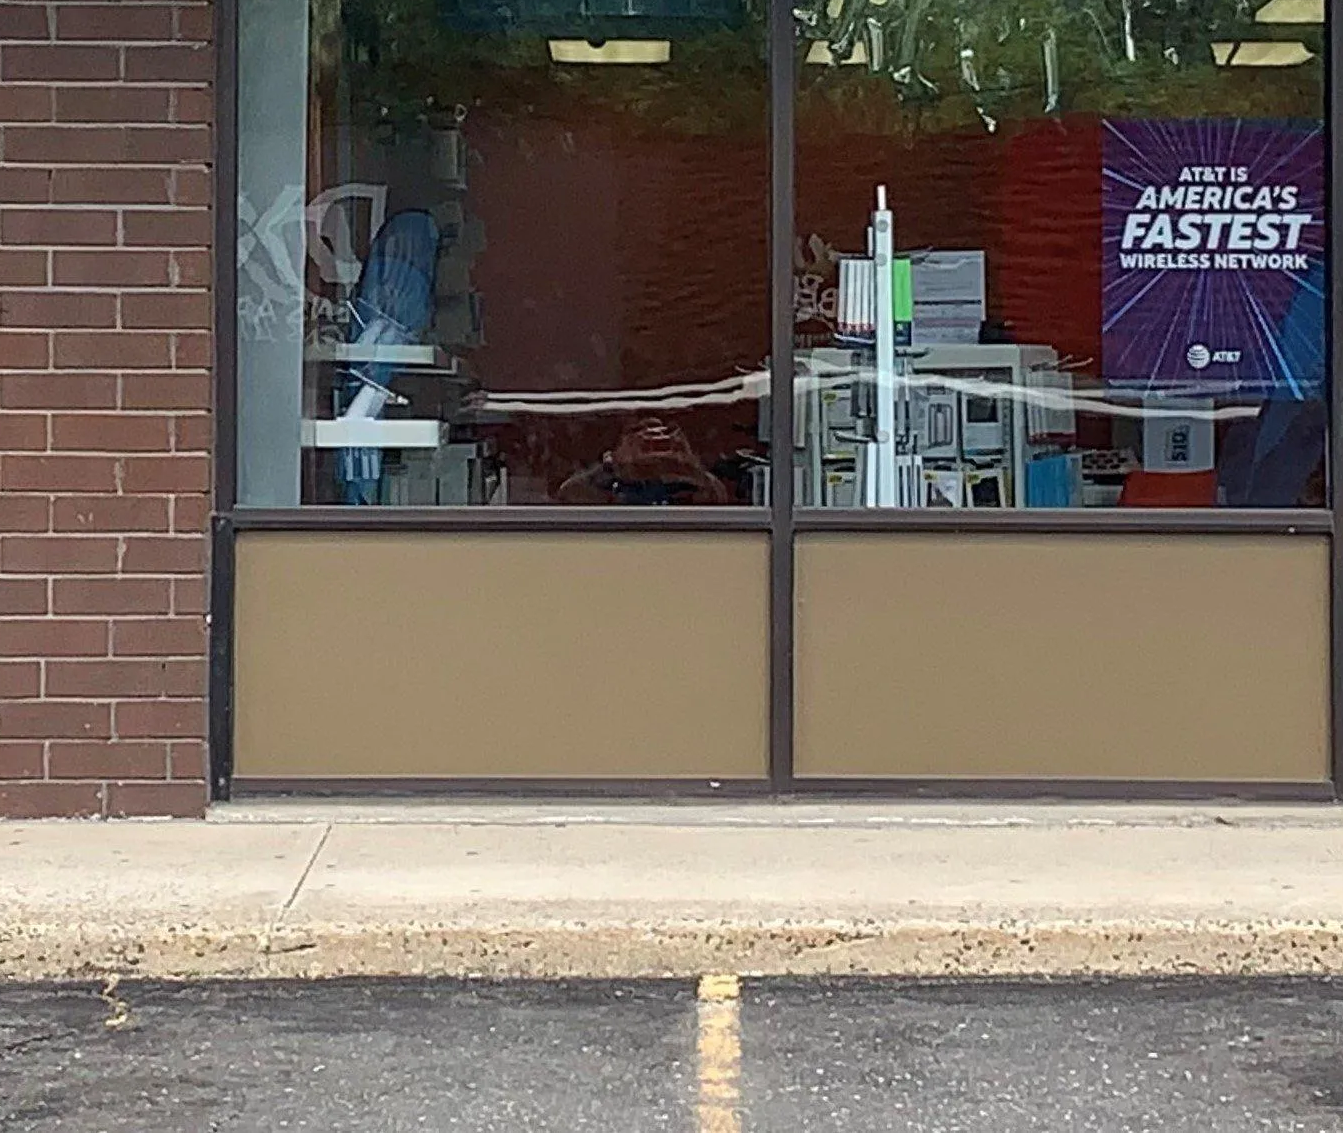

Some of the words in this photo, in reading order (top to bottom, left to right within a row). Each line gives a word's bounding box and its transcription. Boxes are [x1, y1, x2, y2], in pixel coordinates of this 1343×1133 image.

[1178, 166, 1228, 183] AT&T
[1230, 166, 1249, 182] IS
[1135, 185, 1299, 211] AMERICA'S
[1120, 213, 1312, 250] FASTEST
[1119, 253, 1211, 268] WIRELESS
[1214, 253, 1309, 269] NETWORK
